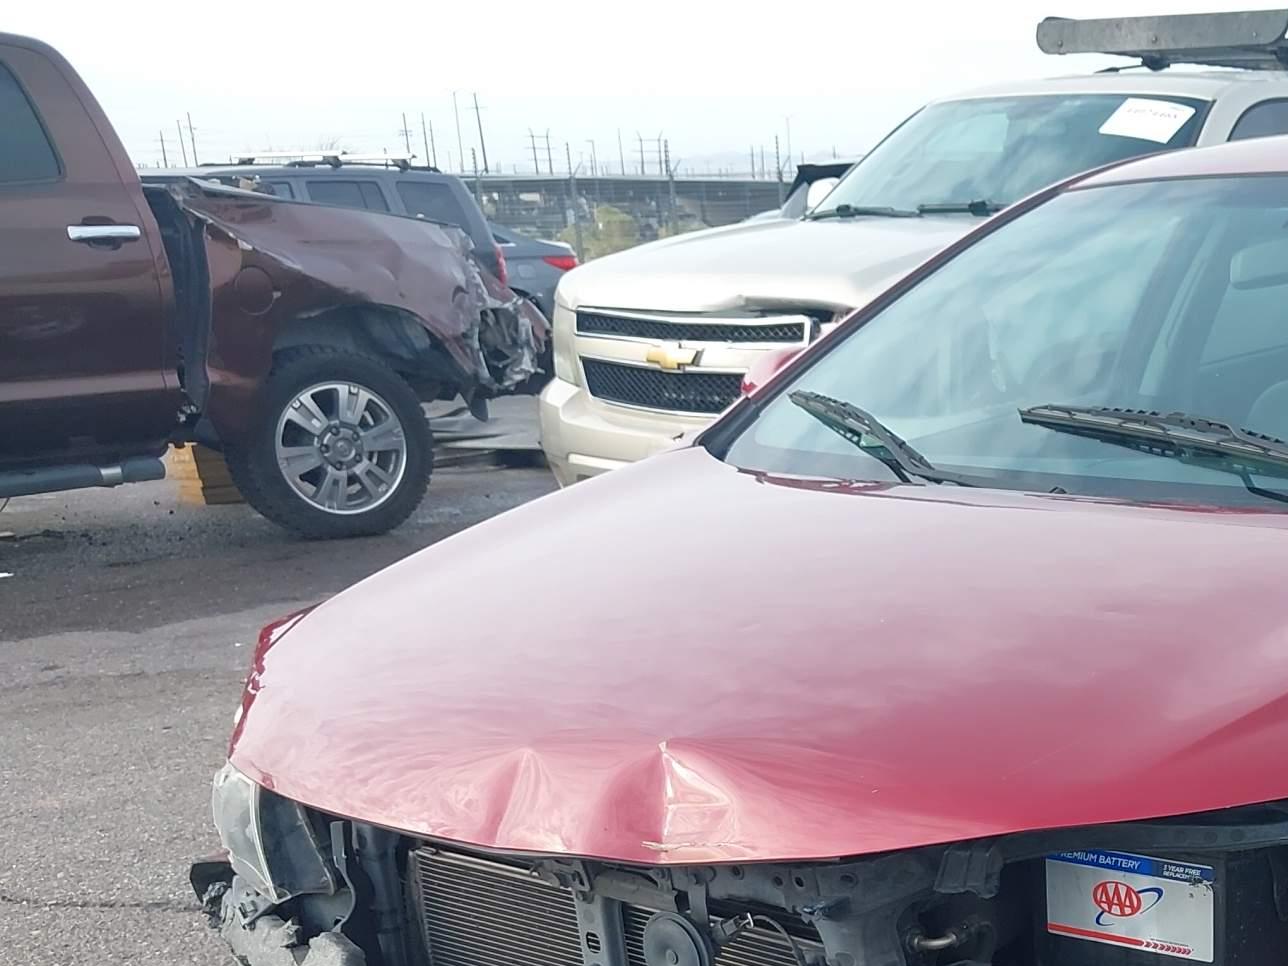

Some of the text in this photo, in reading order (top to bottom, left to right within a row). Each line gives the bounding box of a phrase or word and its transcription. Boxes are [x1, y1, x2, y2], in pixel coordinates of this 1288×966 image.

[1056, 851, 1141, 870] REMIUM BATTERY
[1168, 865, 1185, 873] YEAR
[1185, 868, 1202, 876] FREE
[1097, 883, 1138, 915] AAA
